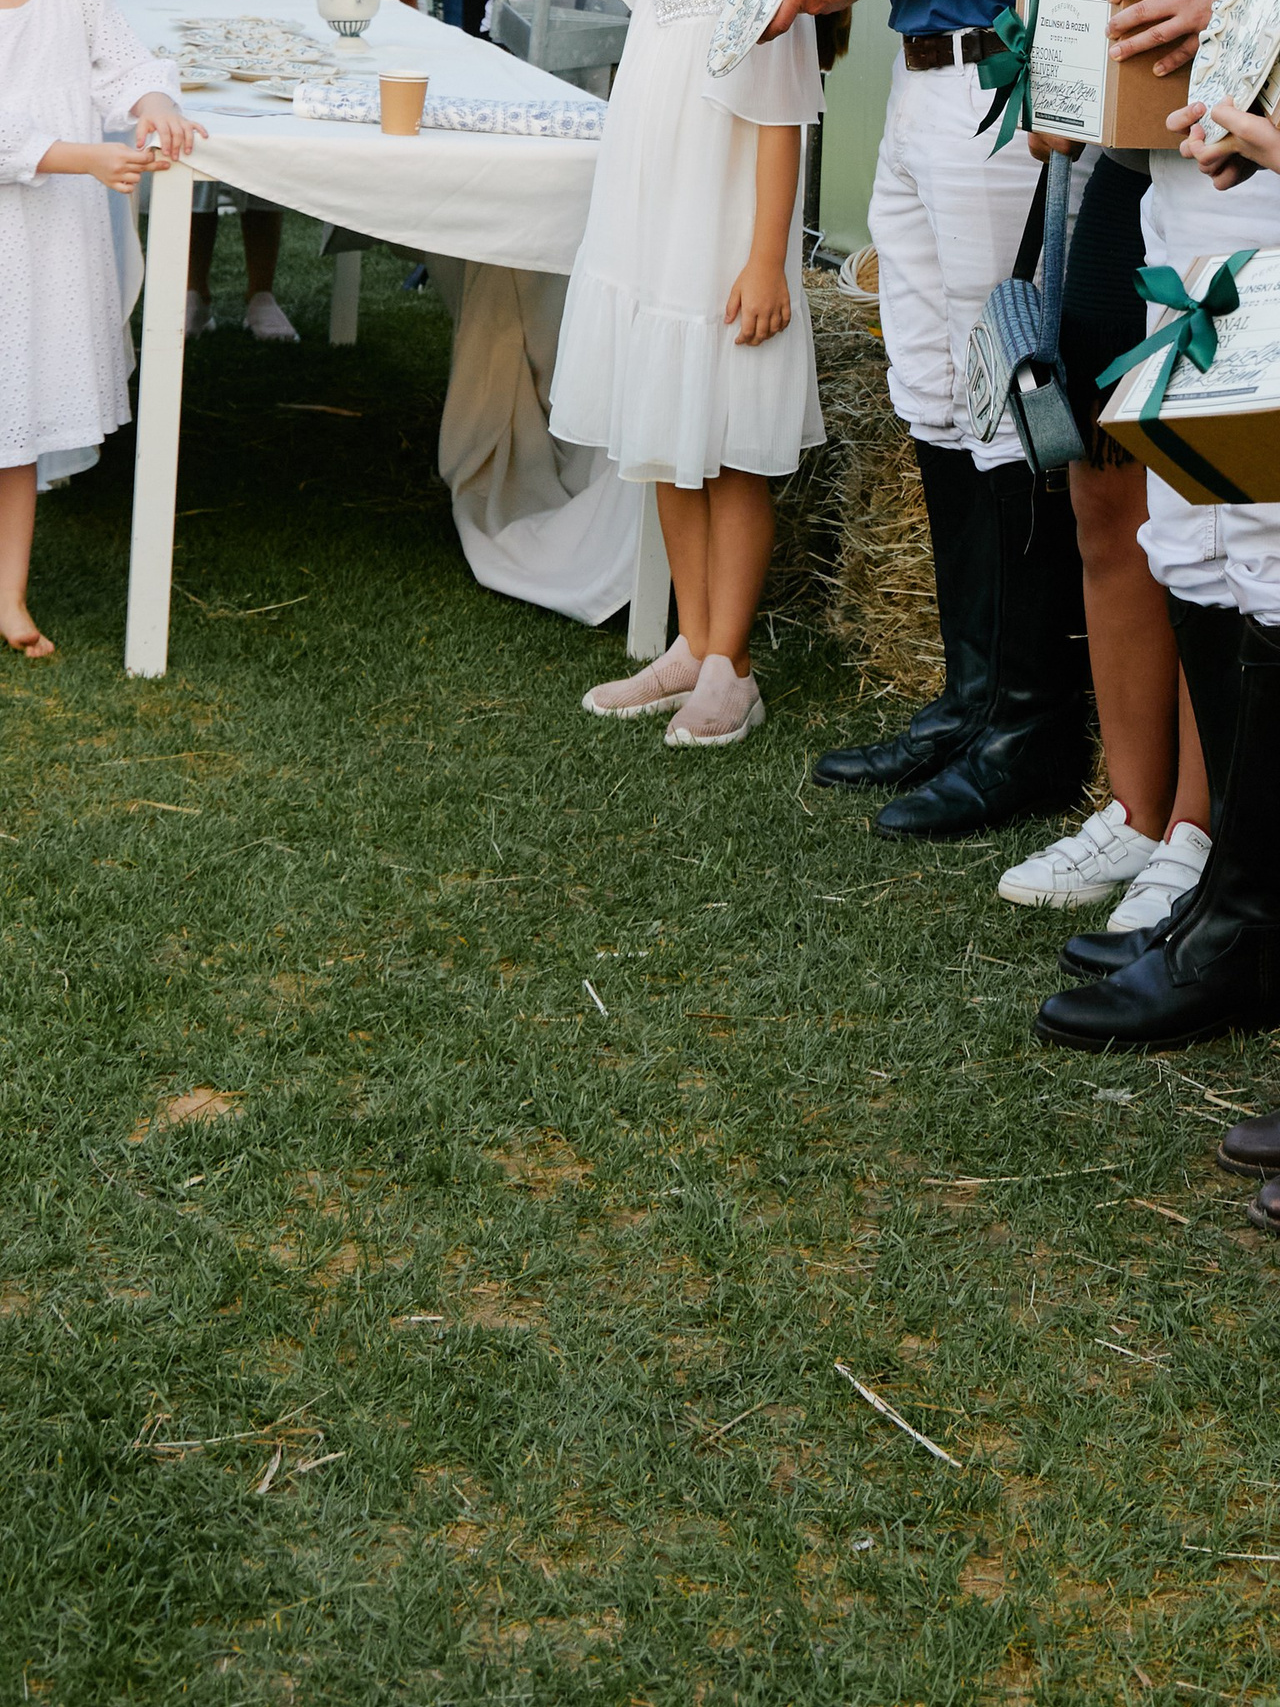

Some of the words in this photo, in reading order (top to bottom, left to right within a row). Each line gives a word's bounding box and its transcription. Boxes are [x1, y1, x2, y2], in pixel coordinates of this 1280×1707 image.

[1071, 22, 1090, 32] ROZEN
[1032, 46, 1063, 62] ERSONAL
[1031, 62, 1059, 77] ELIVERY
